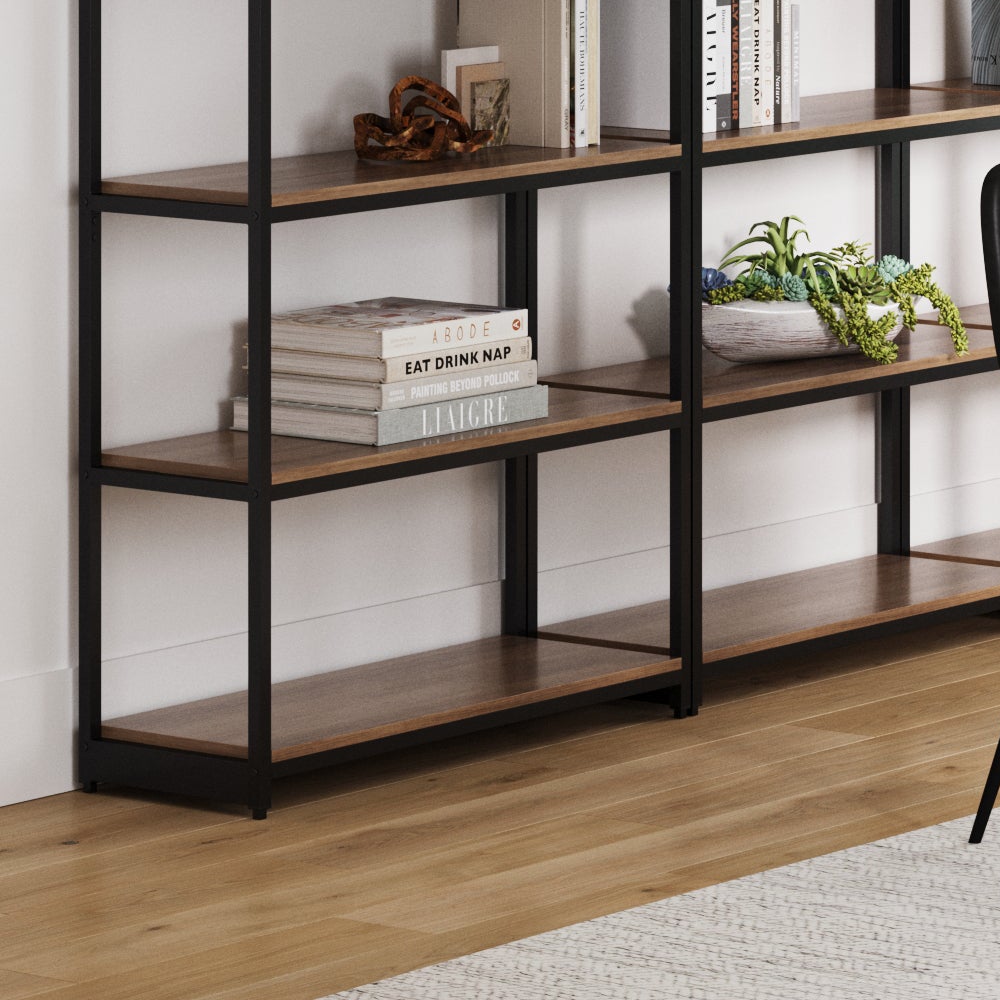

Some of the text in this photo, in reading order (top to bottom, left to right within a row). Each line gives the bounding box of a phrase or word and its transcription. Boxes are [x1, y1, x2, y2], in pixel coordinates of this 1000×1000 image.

[432, 320, 491, 344] ABODE
[404, 358, 431, 375] EAT
[435, 351, 479, 370] DRINK
[482, 346, 512, 363] NAP
[410, 381, 449, 400] PAINTING
[450, 375, 482, 393] BEYOND
[483, 370, 520, 389] POLLOCK
[422, 395, 509, 436] LIAIGRE
